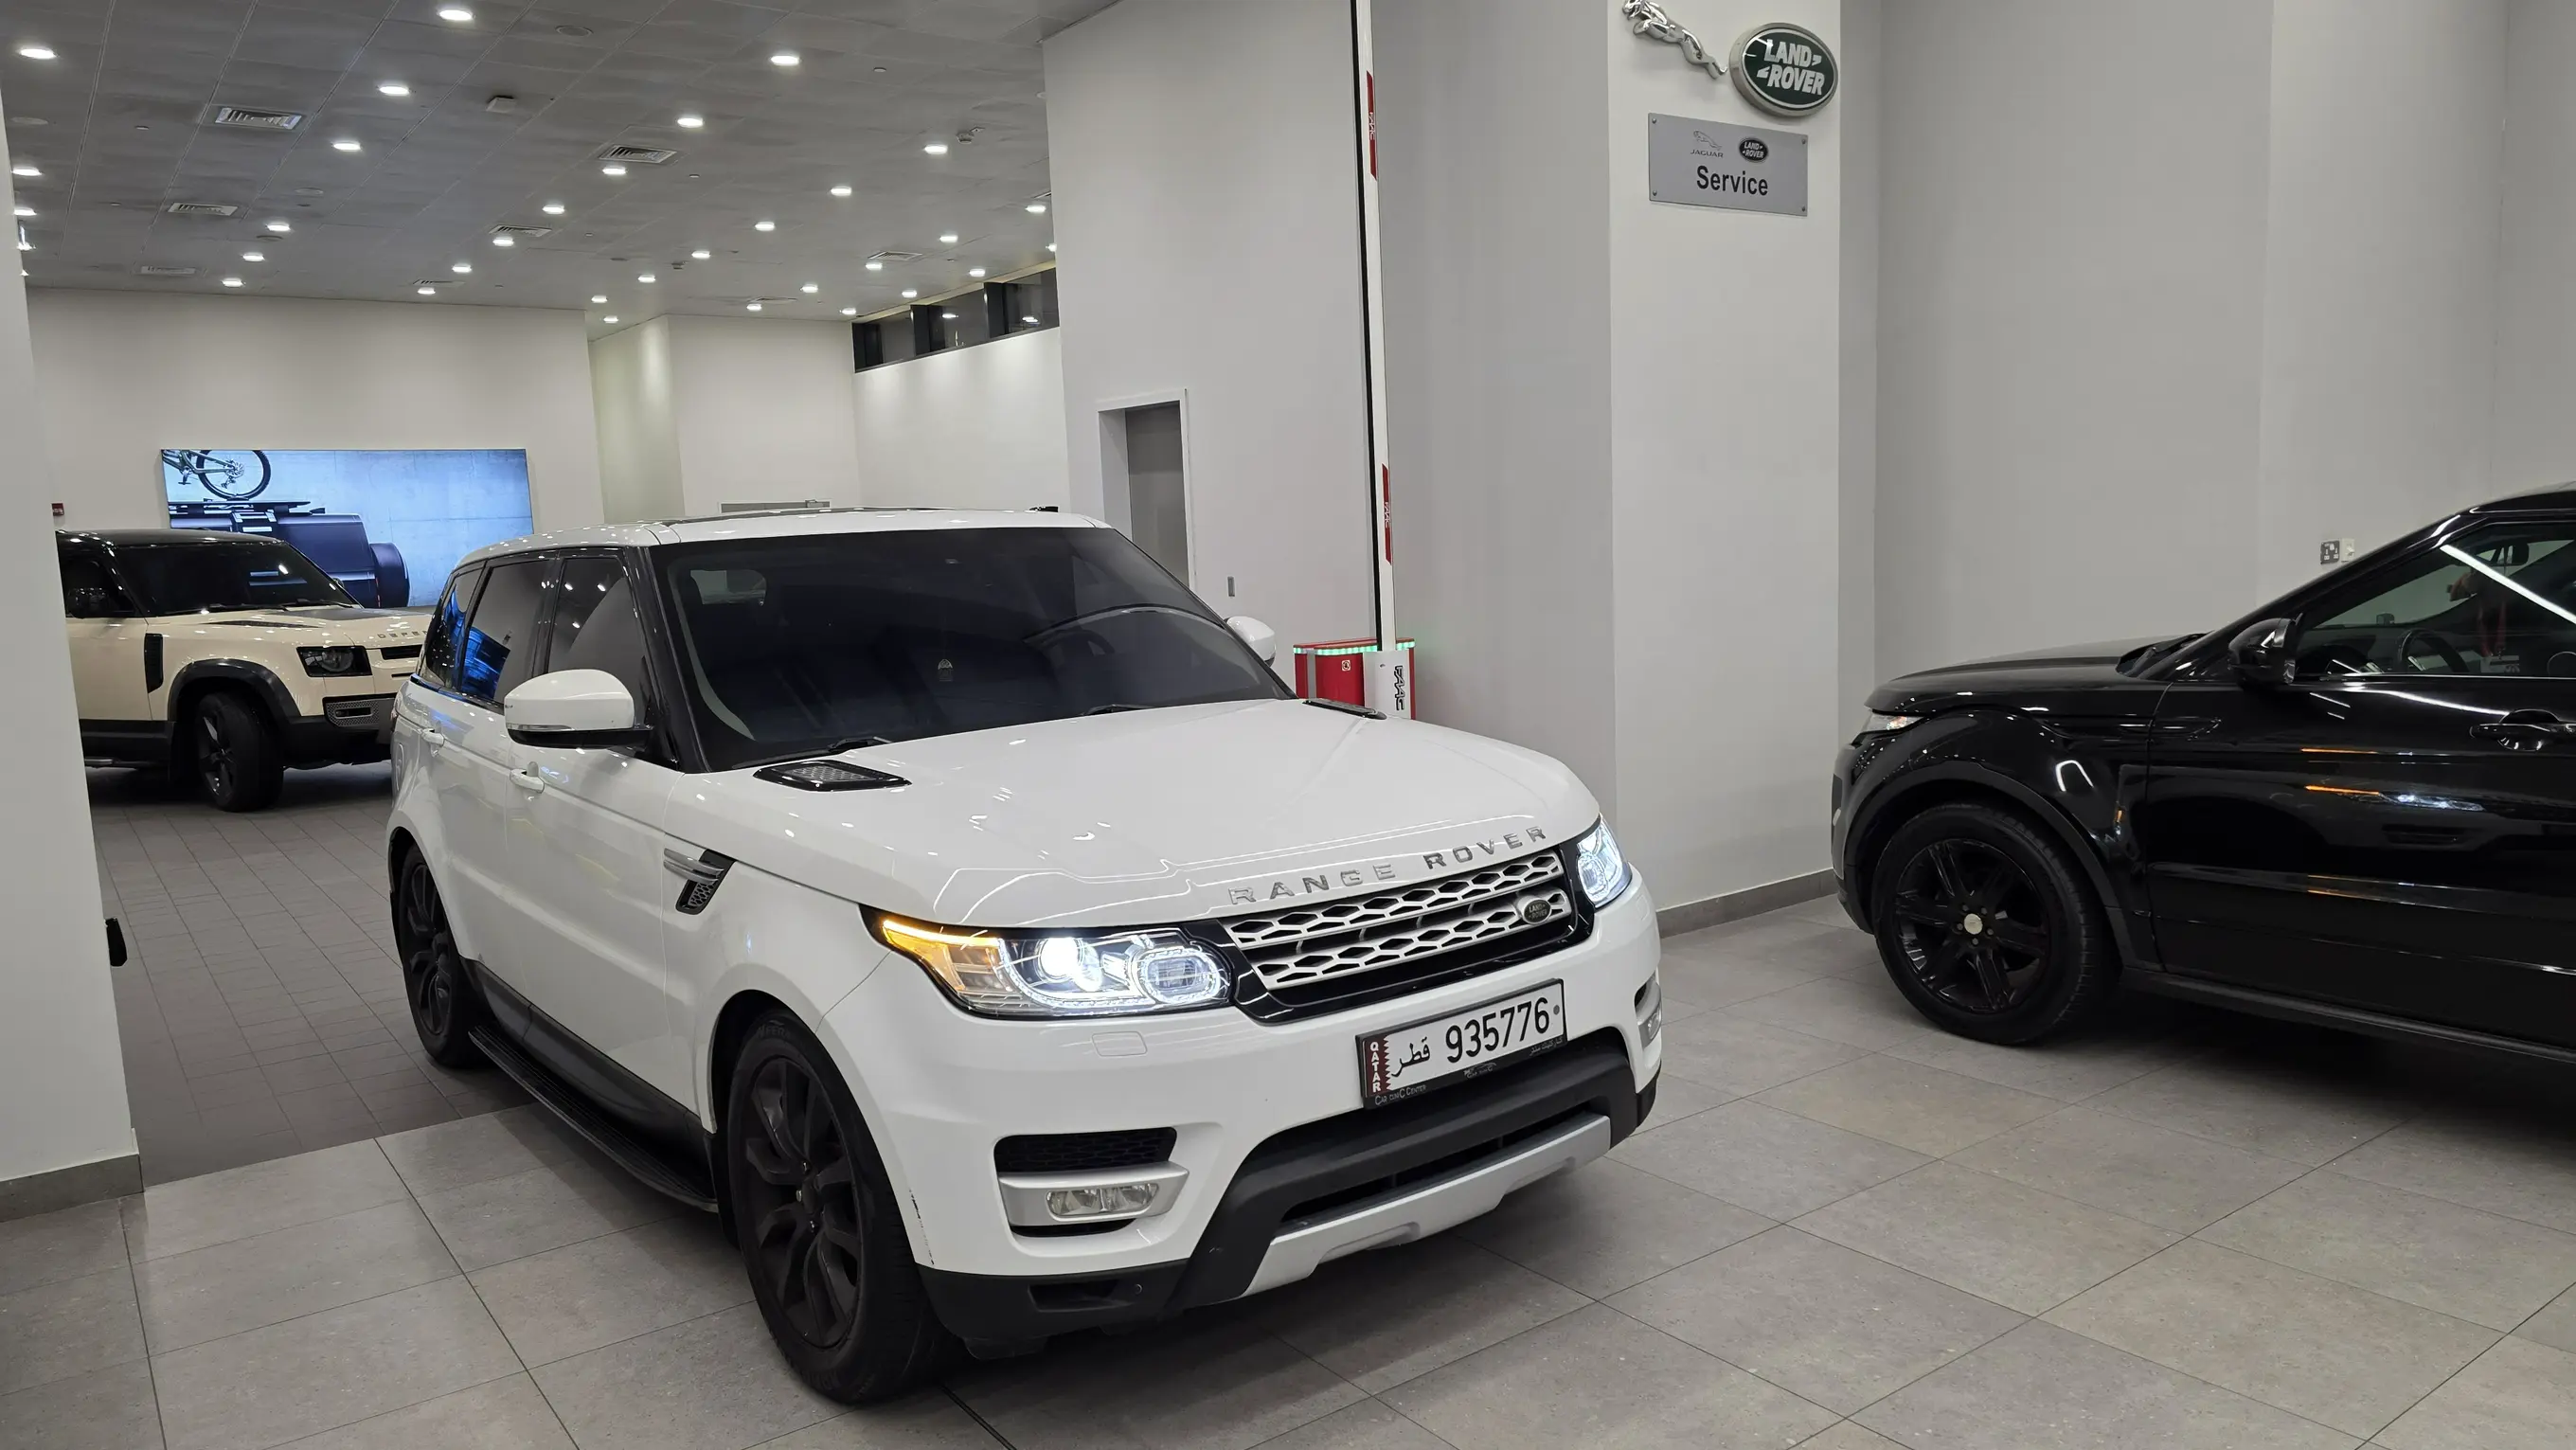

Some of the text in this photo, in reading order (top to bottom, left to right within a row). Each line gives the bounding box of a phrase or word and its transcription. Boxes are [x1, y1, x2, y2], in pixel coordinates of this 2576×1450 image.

[1763, 39, 1813, 68] LAND
[1767, 64, 1825, 96] ROVER
[1690, 149, 1725, 159] JAGUAR
[1744, 141, 1761, 151] LAND
[1744, 149, 1764, 159] ROVER
[1696, 165, 1769, 196] Service
[1227, 825, 1547, 905] RANGE ROVER
[1445, 996, 1550, 1064] 935776
[1369, 1041, 1382, 1093] QATAR
[1391, 1036, 1431, 1078] قطر
